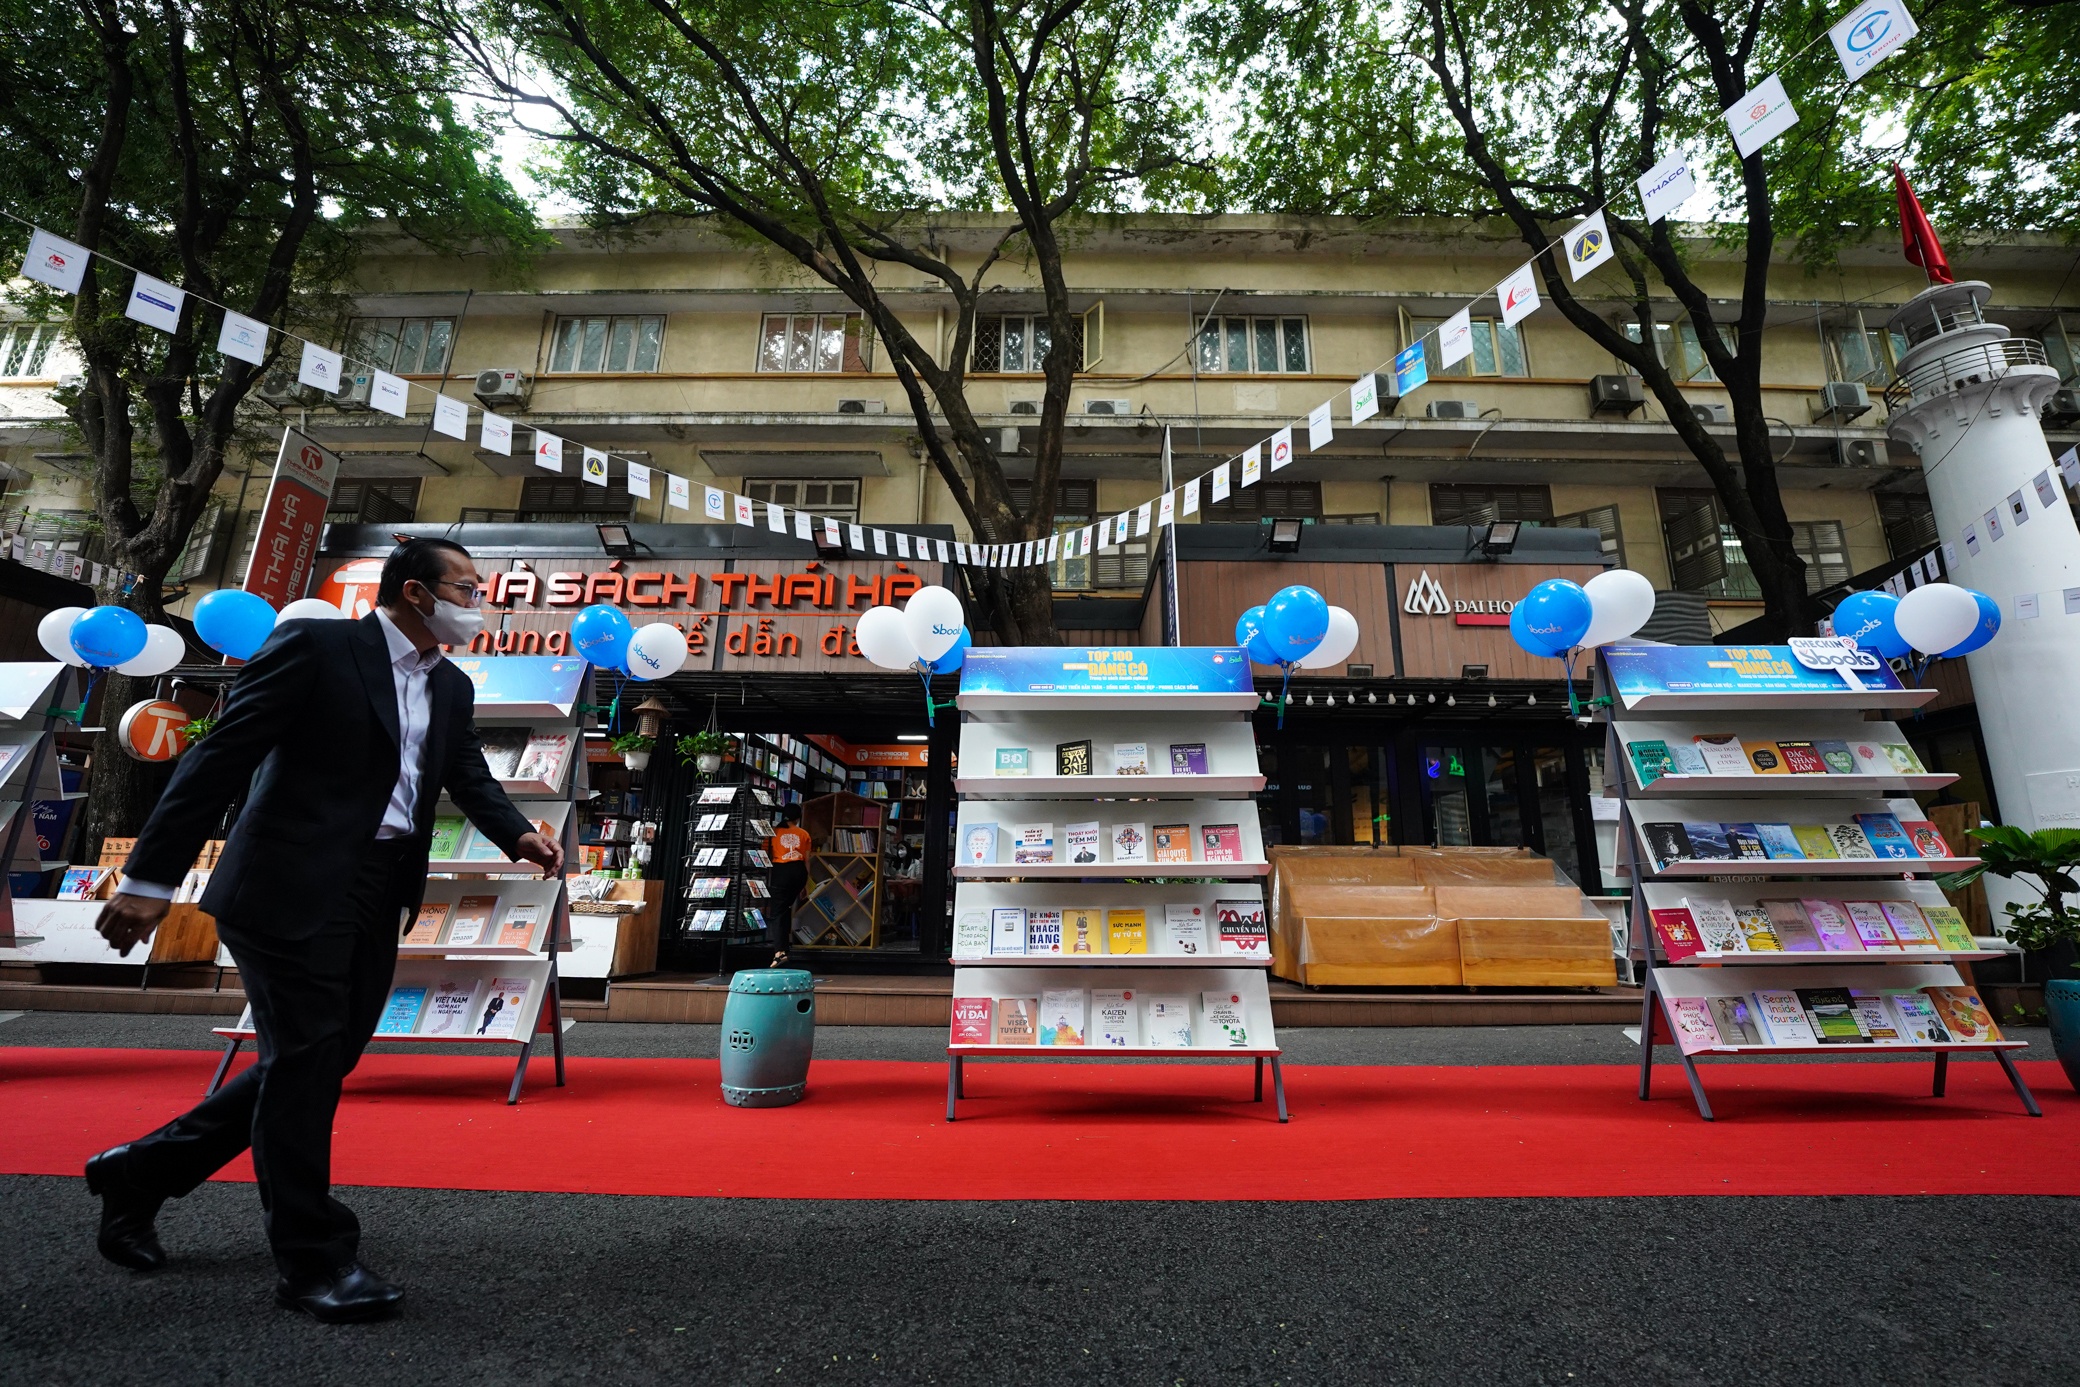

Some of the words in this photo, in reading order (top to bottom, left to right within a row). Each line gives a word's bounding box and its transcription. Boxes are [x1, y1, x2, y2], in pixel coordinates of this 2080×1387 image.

[1645, 166, 1685, 198] THACO
[1443, 335, 1461, 348] Masan
[629, 473, 649, 484] THACO
[263, 532, 291, 586] THÁI
[279, 493, 302, 530] HÀ
[476, 560, 538, 605] HÀ
[546, 560, 701, 606] SÁCH
[711, 562, 836, 607] THÁI
[846, 562, 923, 607] HÀ
[579, 631, 615, 649] Sbooks
[724, 618, 799, 656] dẫn
[1239, 628, 1260, 649] books
[1793, 640, 1844, 649] CHECKIN
[632, 643, 661, 671] Sbooks
[1087, 650, 1110, 662] TOP
[1111, 650, 1133, 662] 100
[1724, 649, 1748, 660] TOP
[1748, 649, 1773, 660] 100
[1799, 649, 1875, 667] Sbooks
[461, 660, 481, 672] 100
[1088, 660, 1126, 676] ĐÁNG
[1128, 660, 1149, 676] CÓ
[1732, 659, 1774, 675] ĐÁNG
[1774, 659, 1795, 675] CÓ
[1001, 753, 1023, 764] BQ
[1785, 749, 1806, 758] ĐẮC
[1063, 756, 1088, 766] DAY
[1789, 756, 1818, 764] NHÂN
[1063, 765, 1088, 775] ONE
[1792, 763, 1814, 771] TÂM
[38, 813, 58, 821] NAM
[419, 905, 446, 915] KHÔNG
[1039, 911, 1060, 919] KHÔNG
[1752, 908, 1766, 917] TIỀN
[1888, 906, 1895, 914] 7
[418, 919, 437, 927] MỘT
[1931, 917, 1945, 925] TINH
[1030, 923, 1060, 933] KHÁCH
[1221, 924, 1250, 934] CHUYỂN
[1252, 923, 1265, 933] ĐỔI
[1030, 932, 1060, 944] HÀNG
[1132, 930, 1143, 938] TẾ
[435, 995, 451, 1005] VIỆT
[451, 996, 469, 1004] NAM
[1762, 994, 1796, 1004] Search
[955, 1007, 967, 1020] VĨ
[968, 1009, 988, 1021] ĐẠI
[1769, 1004, 1797, 1014] Inside
[1767, 1013, 1806, 1024] Yourself
[1000, 1026, 1022, 1035] TUYỆT
